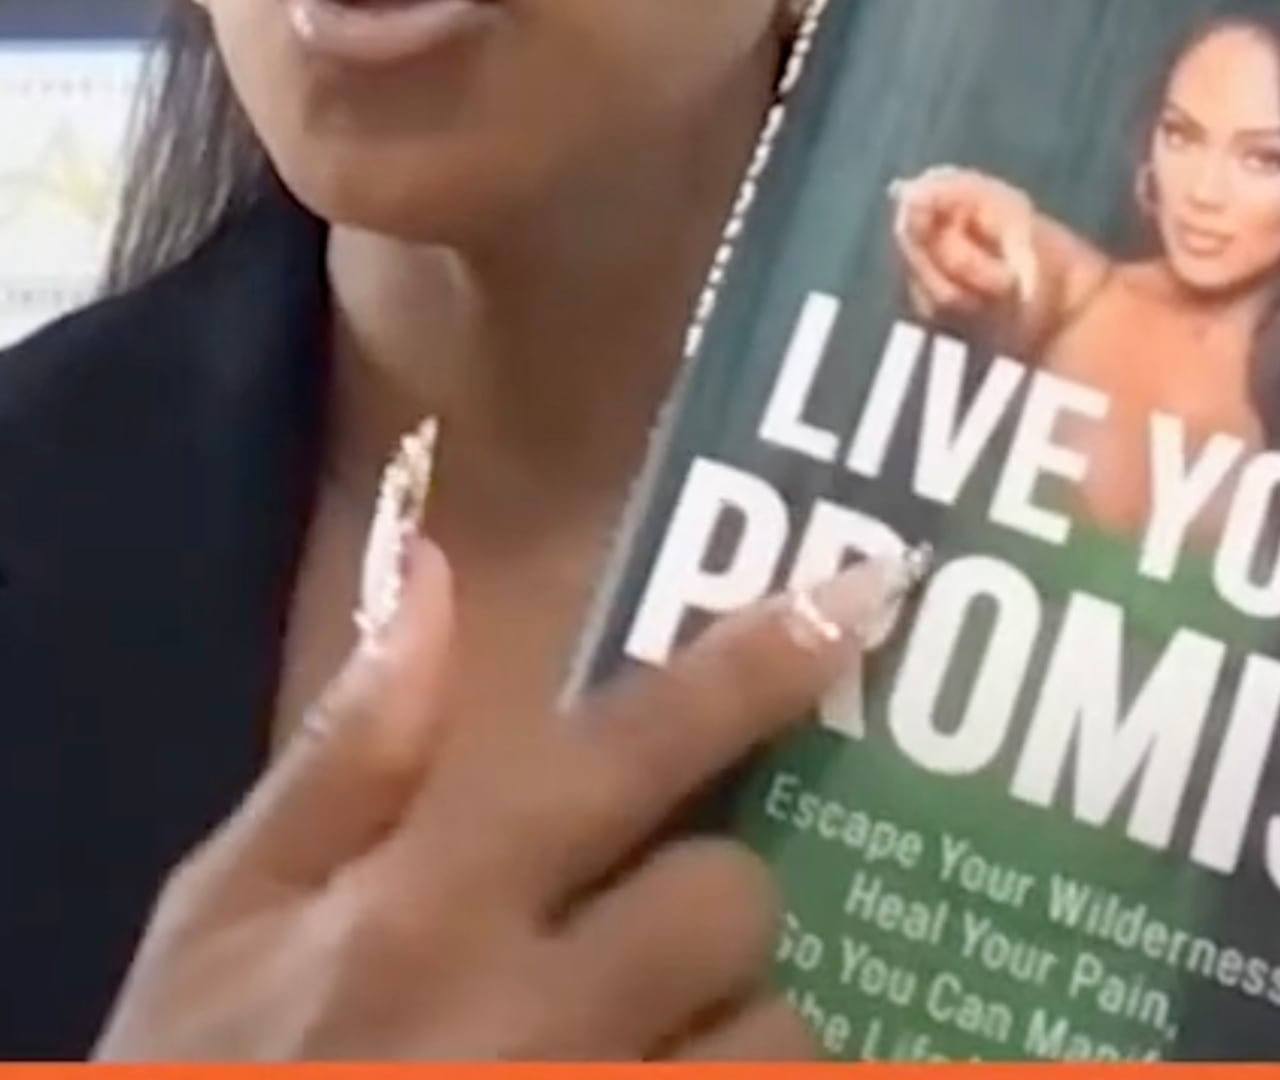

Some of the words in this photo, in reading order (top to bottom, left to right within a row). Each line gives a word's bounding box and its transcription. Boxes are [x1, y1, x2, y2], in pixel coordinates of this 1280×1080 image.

[756, 290, 1112, 546] LIVE
[763, 774, 922, 868] Escape
[935, 834, 1036, 908] Your
[837, 936, 917, 1006] You
[926, 970, 1014, 1044] Can
[844, 871, 948, 945] Heal
[960, 910, 1058, 986] Your
[1069, 950, 1178, 1040] Pain,
